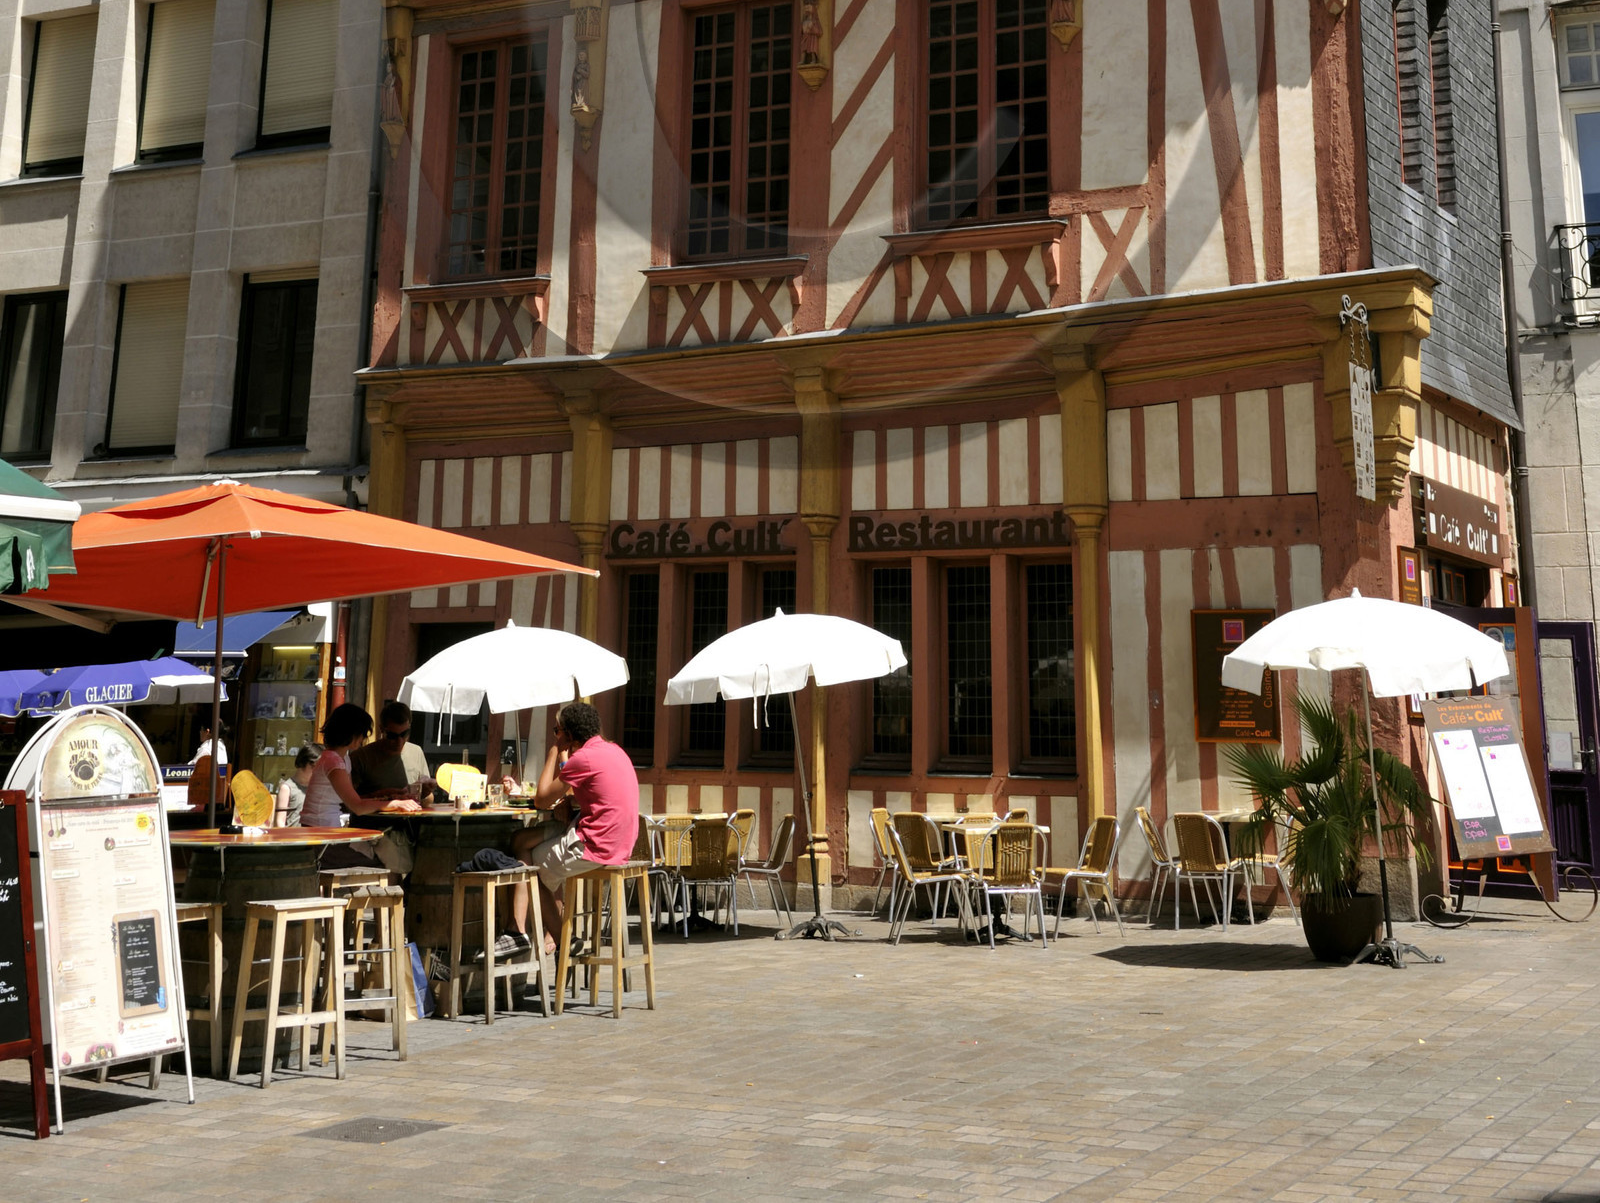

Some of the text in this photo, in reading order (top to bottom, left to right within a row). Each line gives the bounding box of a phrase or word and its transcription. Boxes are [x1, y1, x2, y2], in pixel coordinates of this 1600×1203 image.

[848, 510, 1067, 548] Restaurant
[1439, 514, 1461, 546] Café
[85, 683, 133, 703] GLACIER
[1440, 712, 1467, 725] Café
[68, 739, 98, 751] AMOUR
